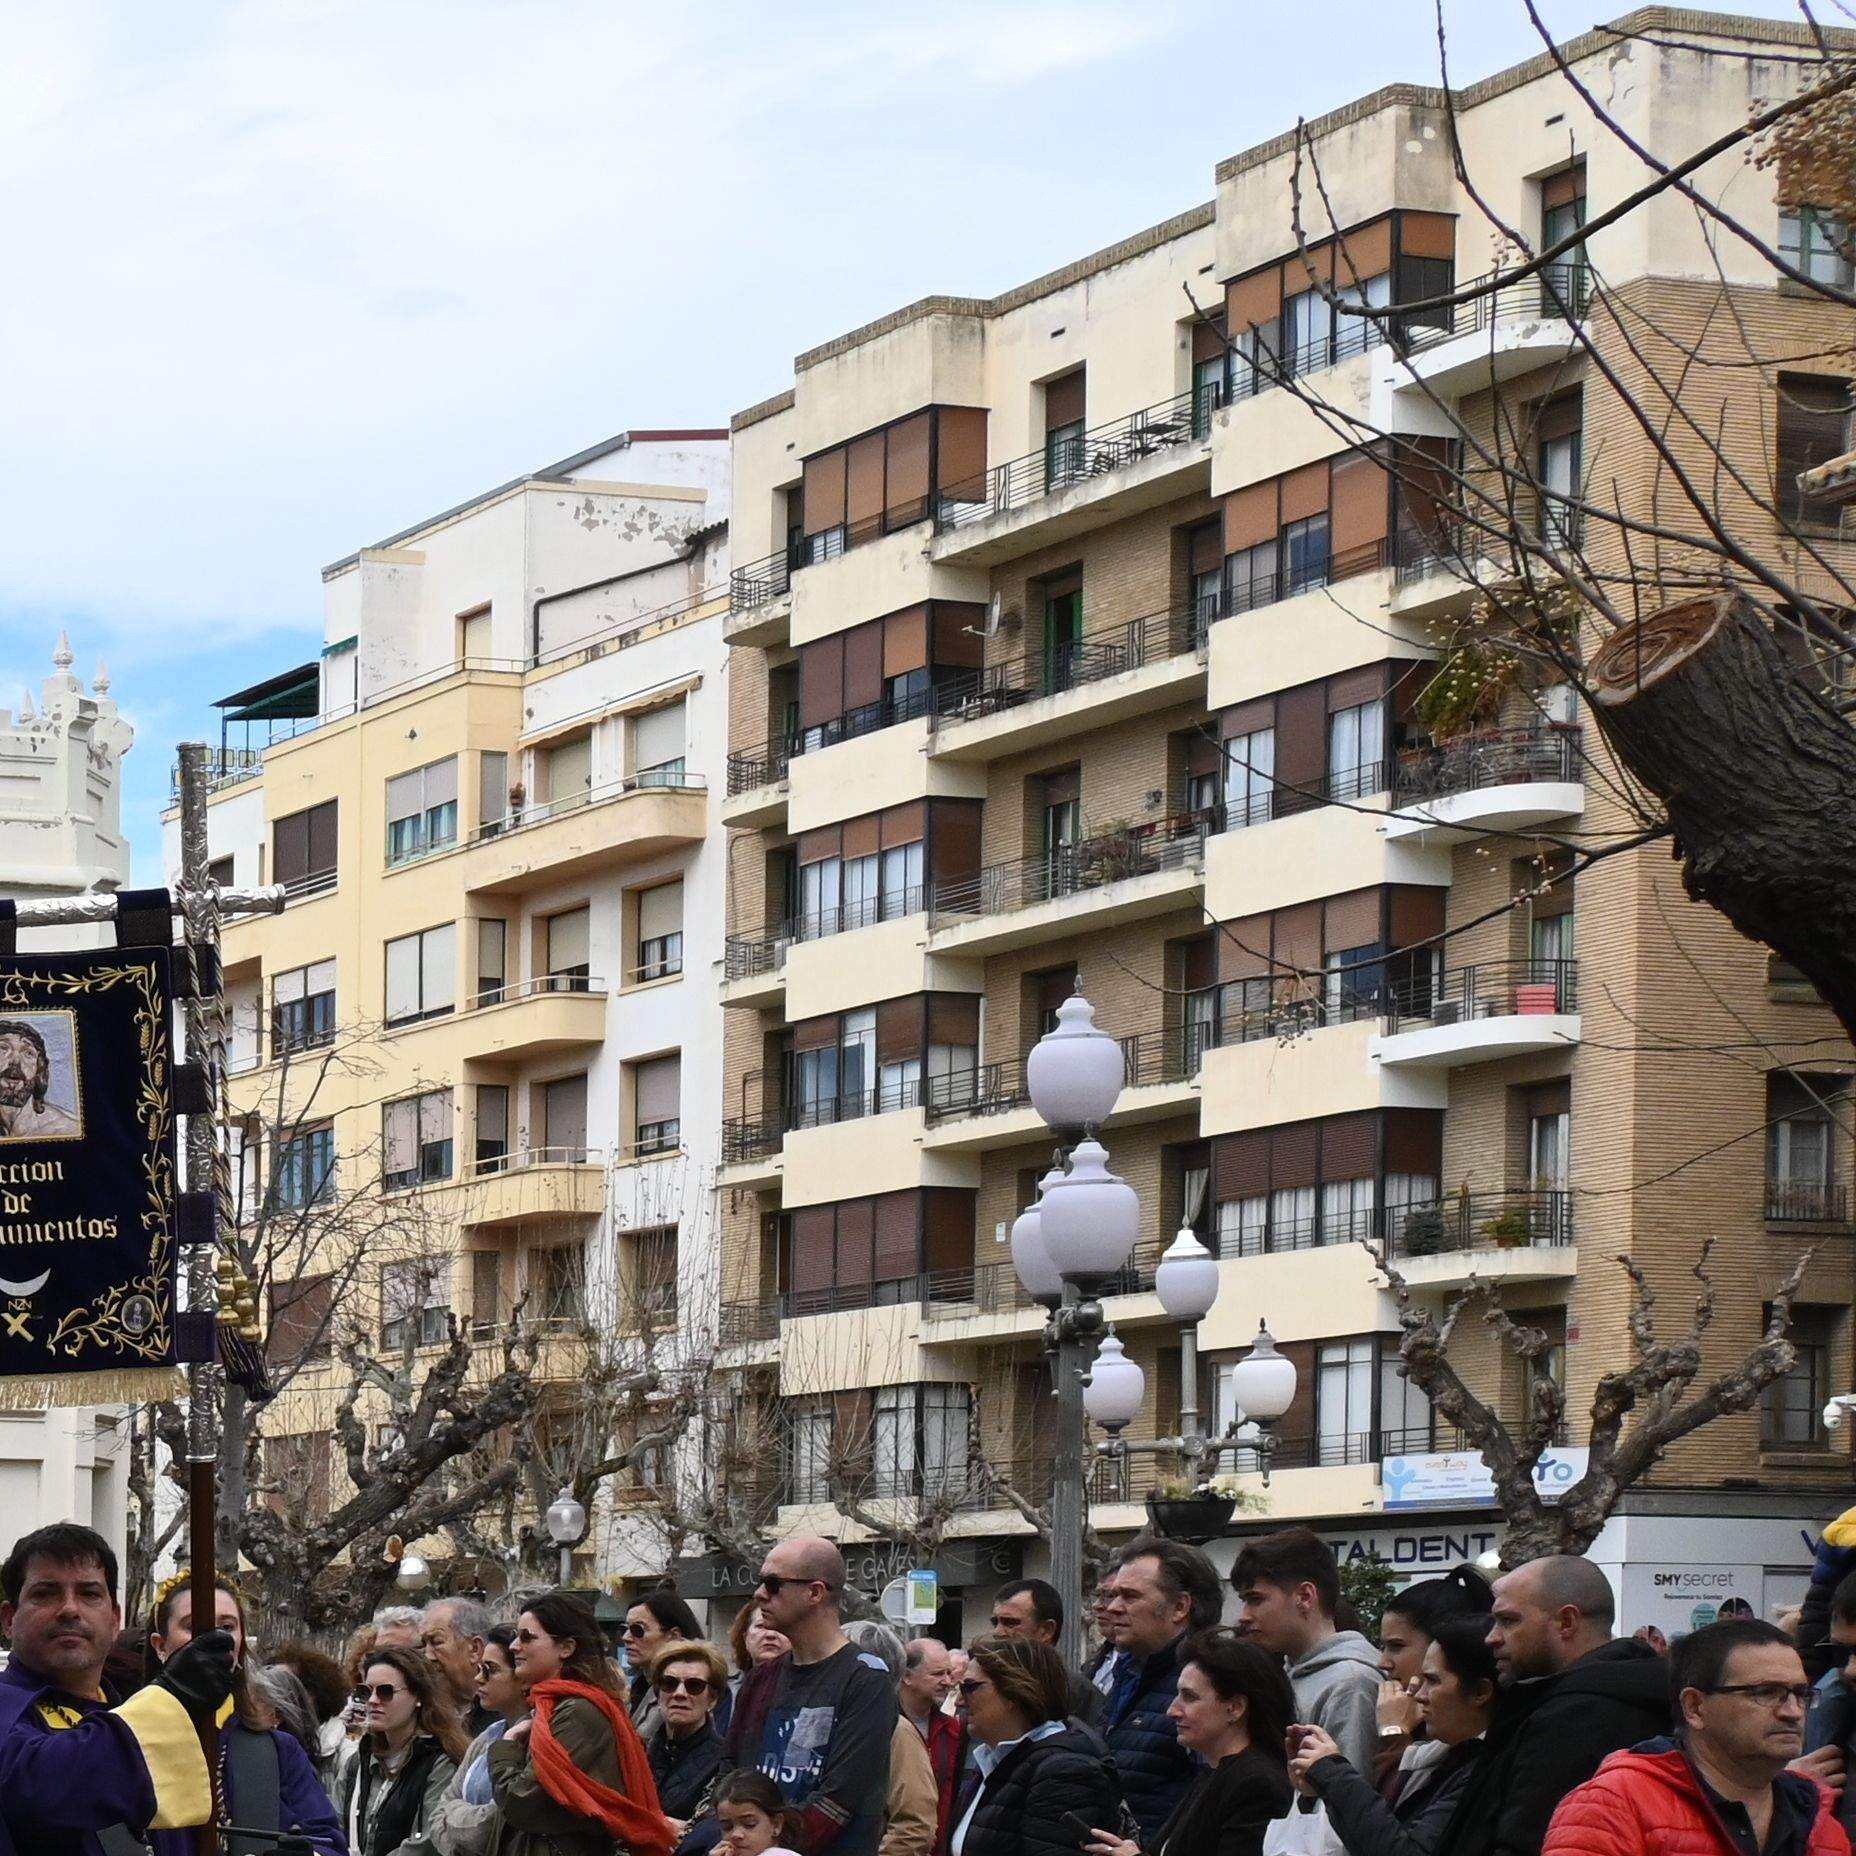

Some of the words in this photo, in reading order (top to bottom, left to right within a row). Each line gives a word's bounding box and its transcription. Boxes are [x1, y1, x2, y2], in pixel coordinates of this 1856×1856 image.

[0, 1189, 32, 1214] de
[1329, 1532, 1496, 1563] TALDENT
[711, 1569, 732, 1587] LA
[845, 1559, 856, 1581] E
